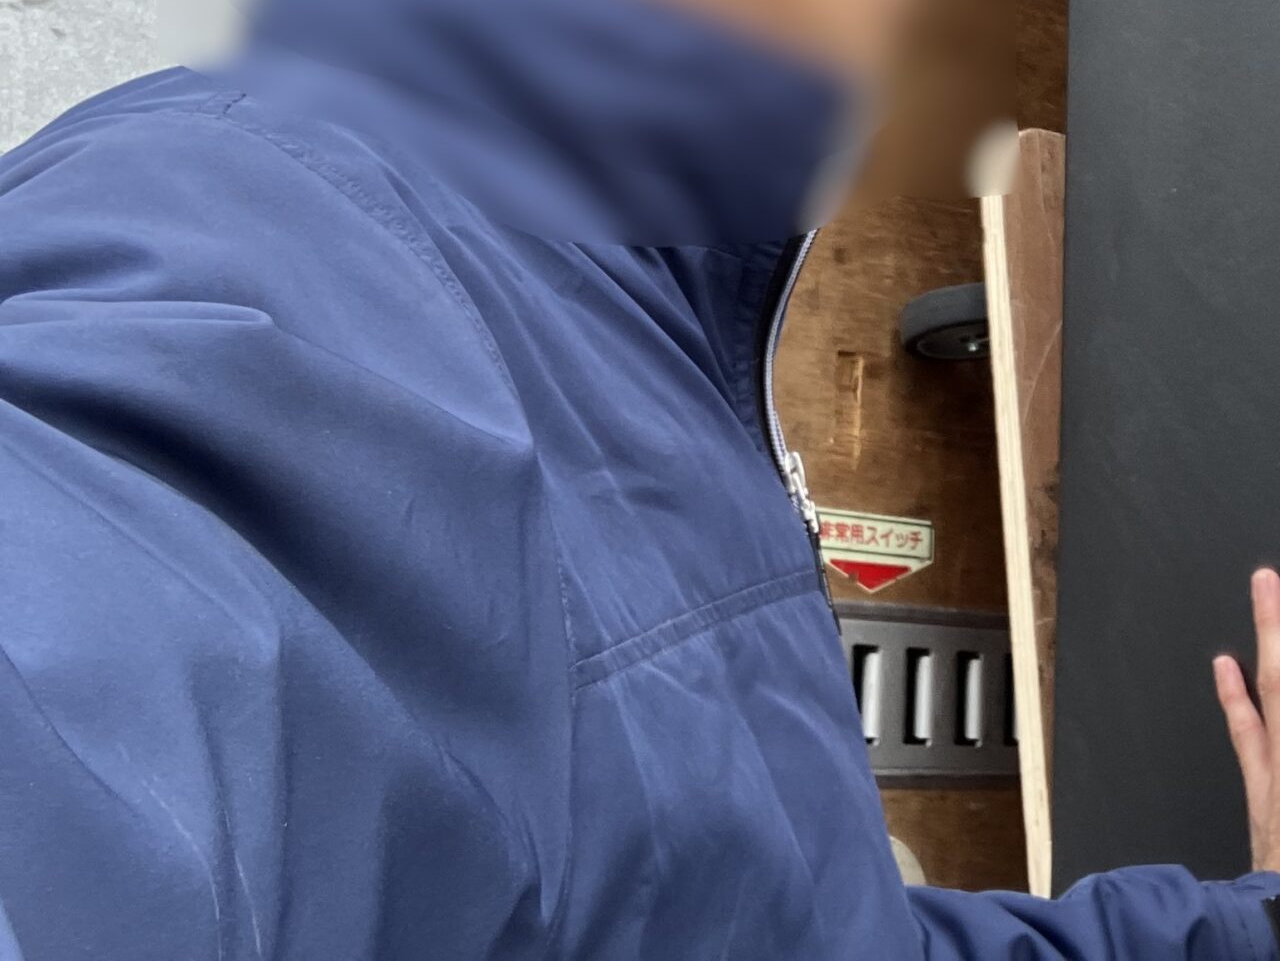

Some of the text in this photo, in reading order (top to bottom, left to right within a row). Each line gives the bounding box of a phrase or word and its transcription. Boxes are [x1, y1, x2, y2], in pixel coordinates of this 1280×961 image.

[820, 520, 923, 550] 非常用スイッチ
